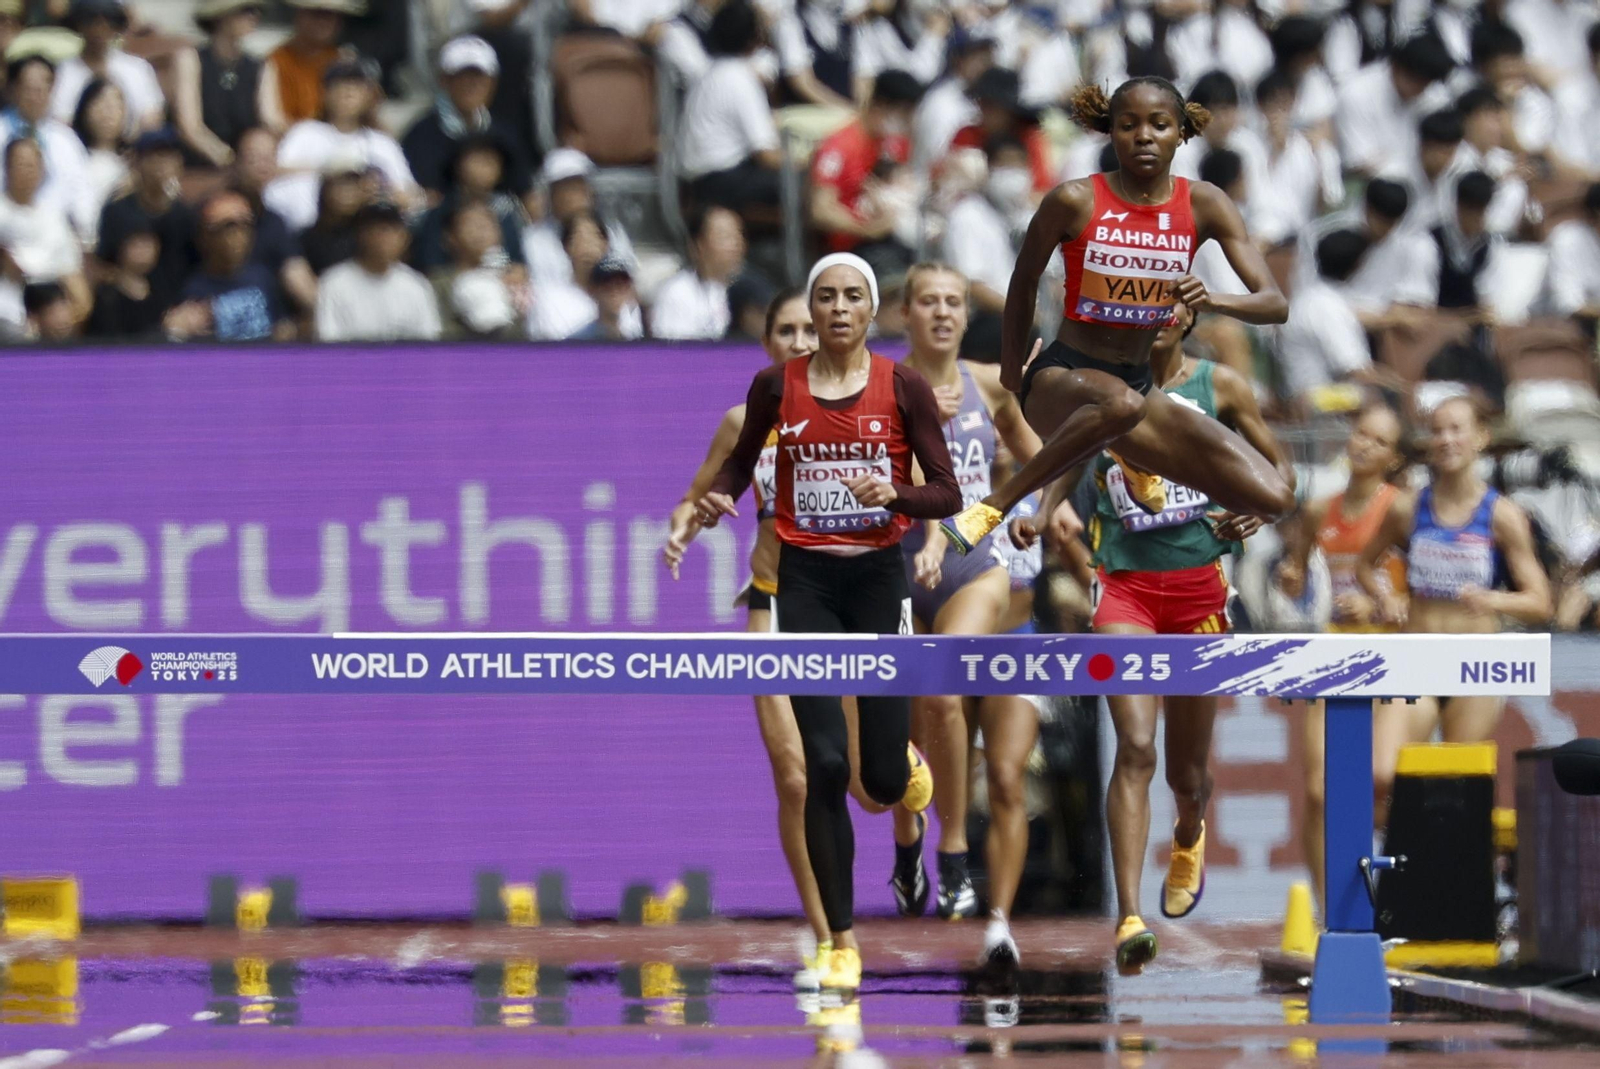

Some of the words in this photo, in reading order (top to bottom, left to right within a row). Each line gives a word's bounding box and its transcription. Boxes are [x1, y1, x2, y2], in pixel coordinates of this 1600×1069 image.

[1095, 226, 1191, 250] BAHRAIN
[1087, 250, 1186, 273] HONDA
[1104, 277, 1164, 302] YAVI
[785, 442, 888, 463] TUNISIA
[946, 438, 986, 471] SA
[795, 465, 888, 482] HONDA
[797, 490, 866, 512] BOUZA
[1114, 484, 1202, 513] ALYEW
[0, 482, 752, 633] erythin
[151, 652, 185, 661] WORLD
[187, 652, 237, 661] ATHLETICS
[151, 661, 237, 670] CHAMPIONSHIPS
[311, 653, 429, 679] WORLD
[440, 652, 616, 679] ATHLETICS
[625, 653, 898, 681] CHAMPIONSHIPS
[1460, 661, 1536, 683] NISHI
